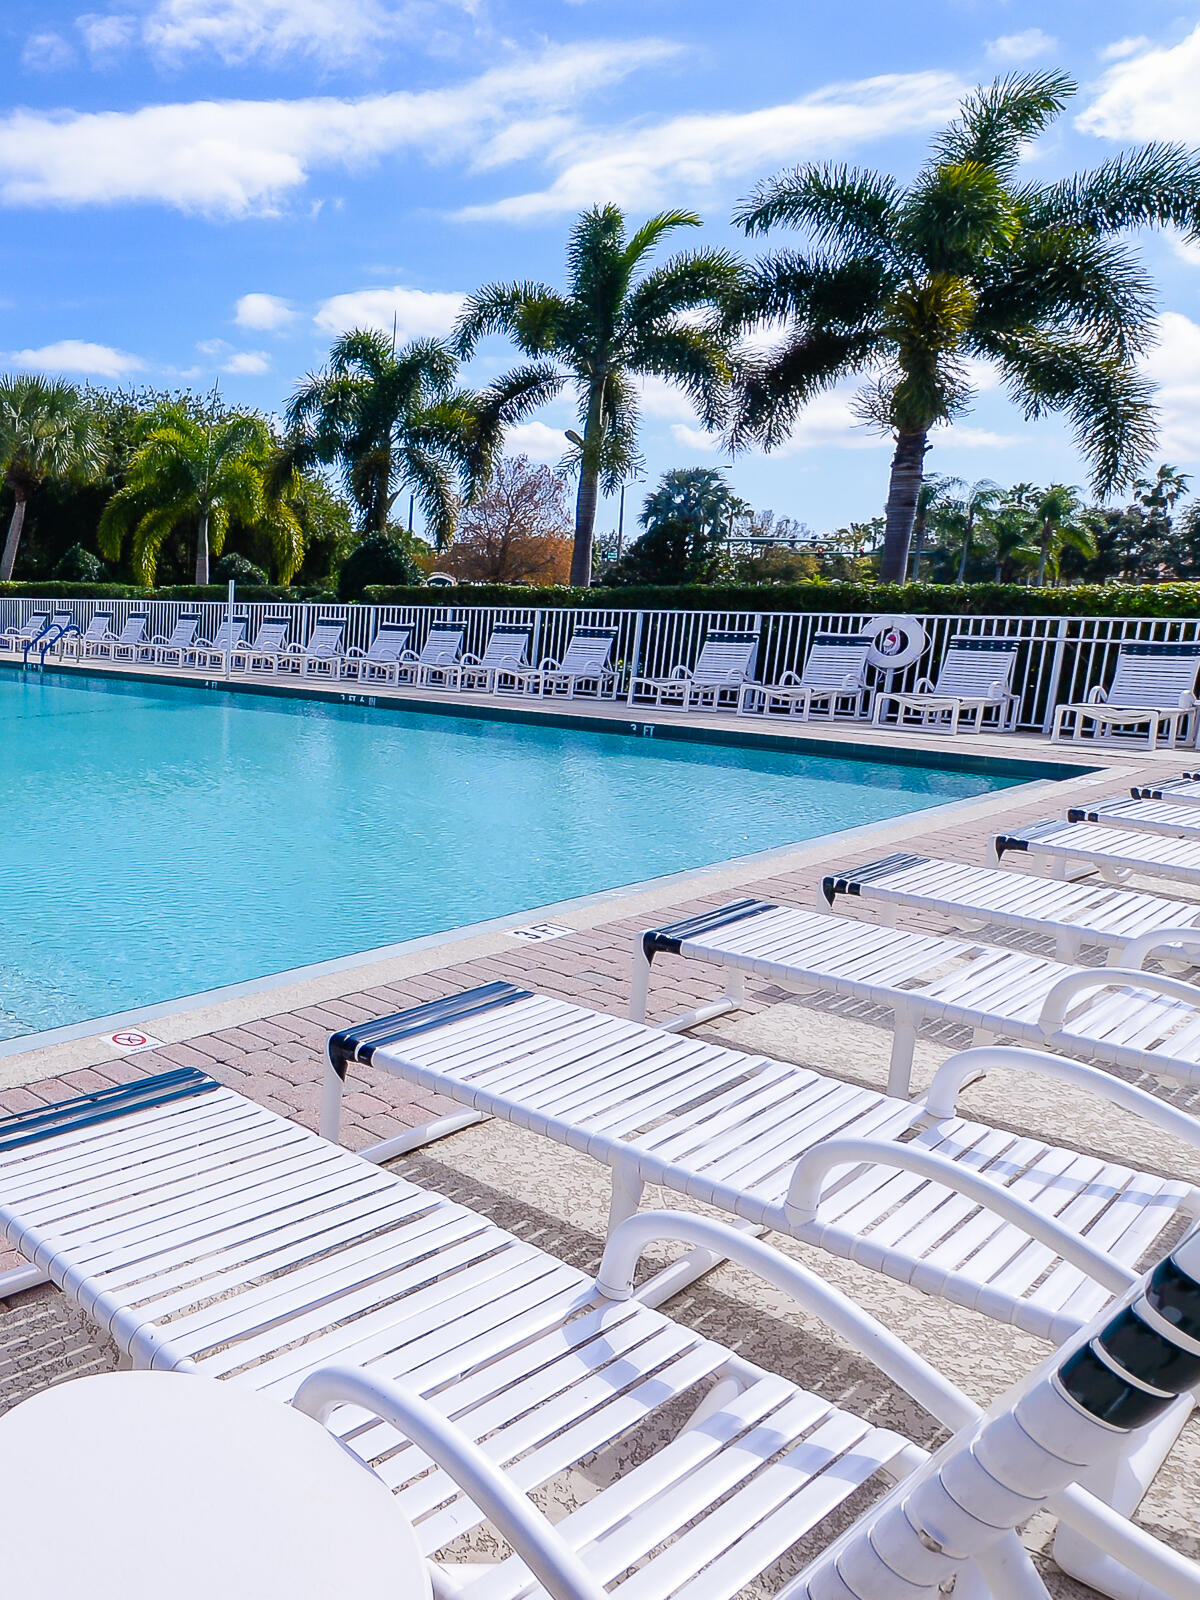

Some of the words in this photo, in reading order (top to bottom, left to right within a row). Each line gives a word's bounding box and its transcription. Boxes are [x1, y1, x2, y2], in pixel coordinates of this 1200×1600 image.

[643, 725, 655, 736] FT
[513, 931, 541, 939] 3
[530, 923, 567, 936] FT
